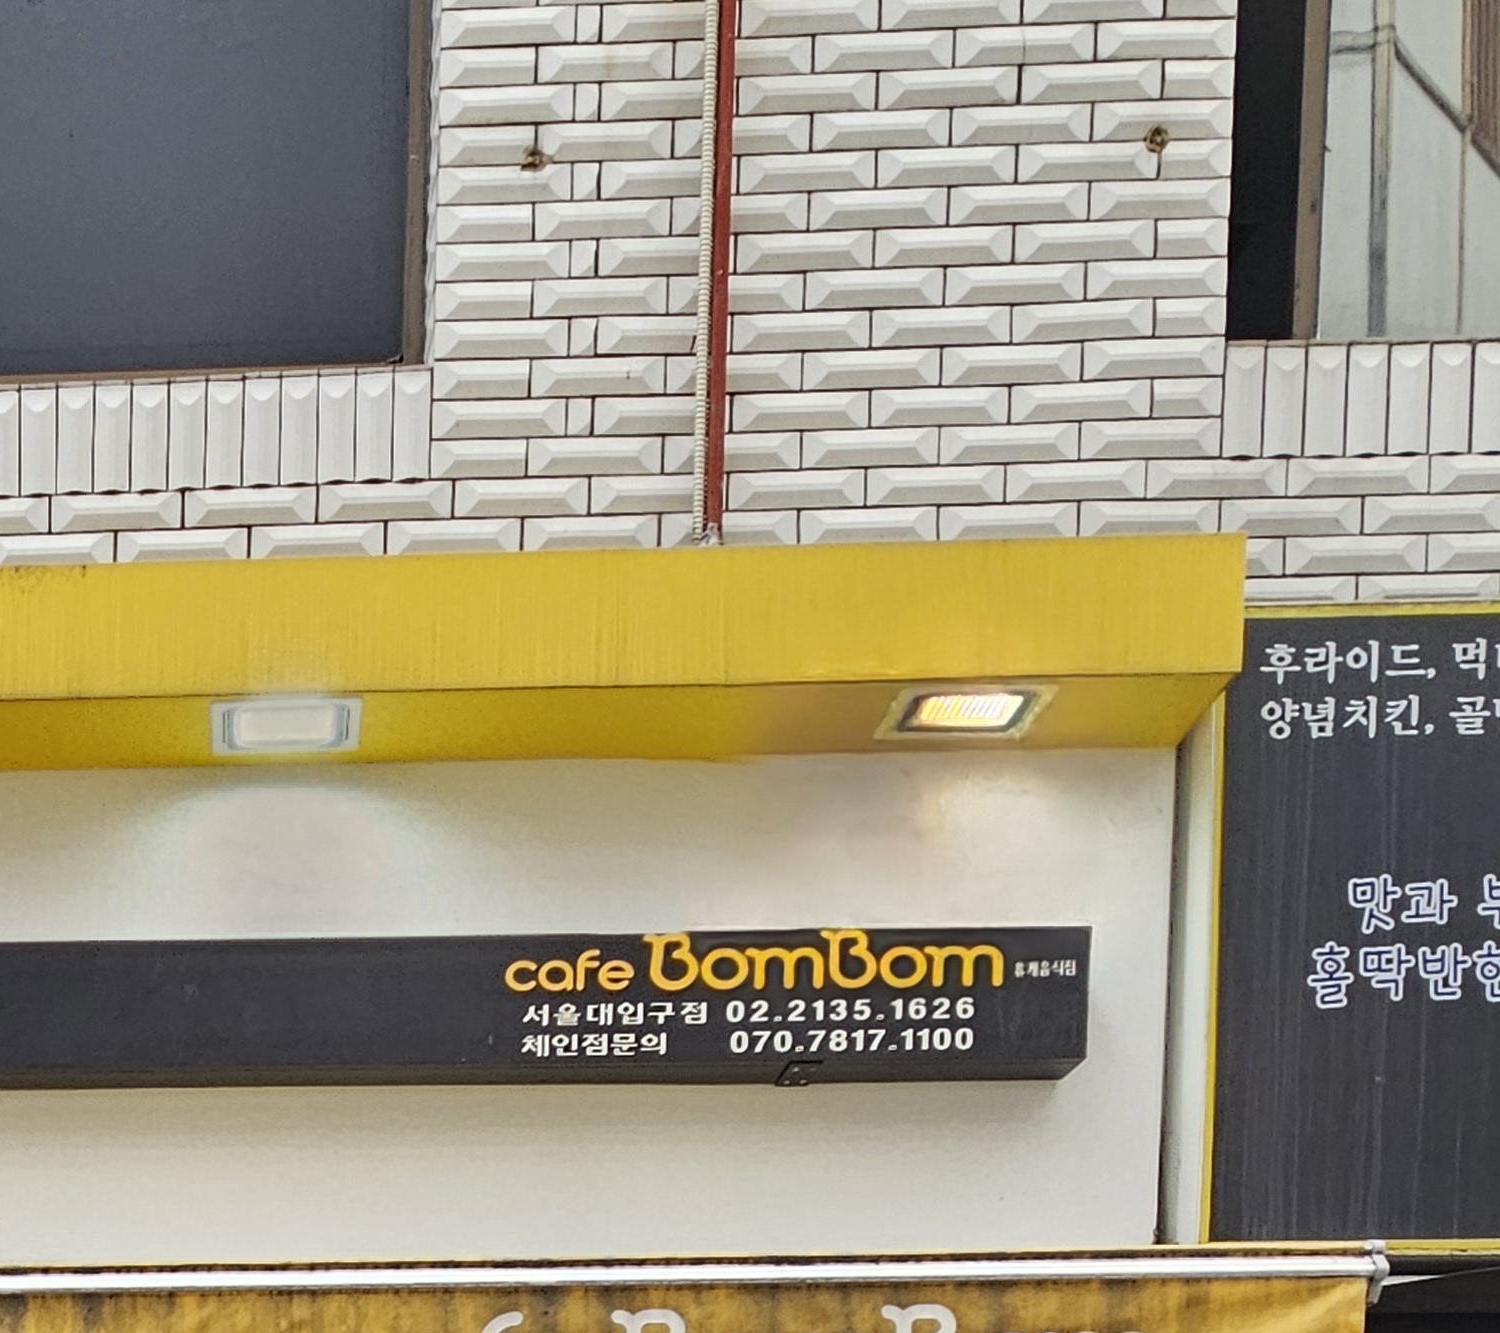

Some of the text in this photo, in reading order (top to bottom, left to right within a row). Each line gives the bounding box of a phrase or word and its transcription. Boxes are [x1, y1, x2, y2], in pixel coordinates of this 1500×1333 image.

[1260, 639, 1436, 685] 후라이드,
[1260, 694, 1434, 739] 양념치킨,
[1348, 873, 1458, 935] 맛과
[504, 928, 1004, 993] cafe BomBom
[521, 996, 976, 1027] 서울대입구점 02.2135.1626
[729, 1026, 976, 1054] 070.7817.1100
